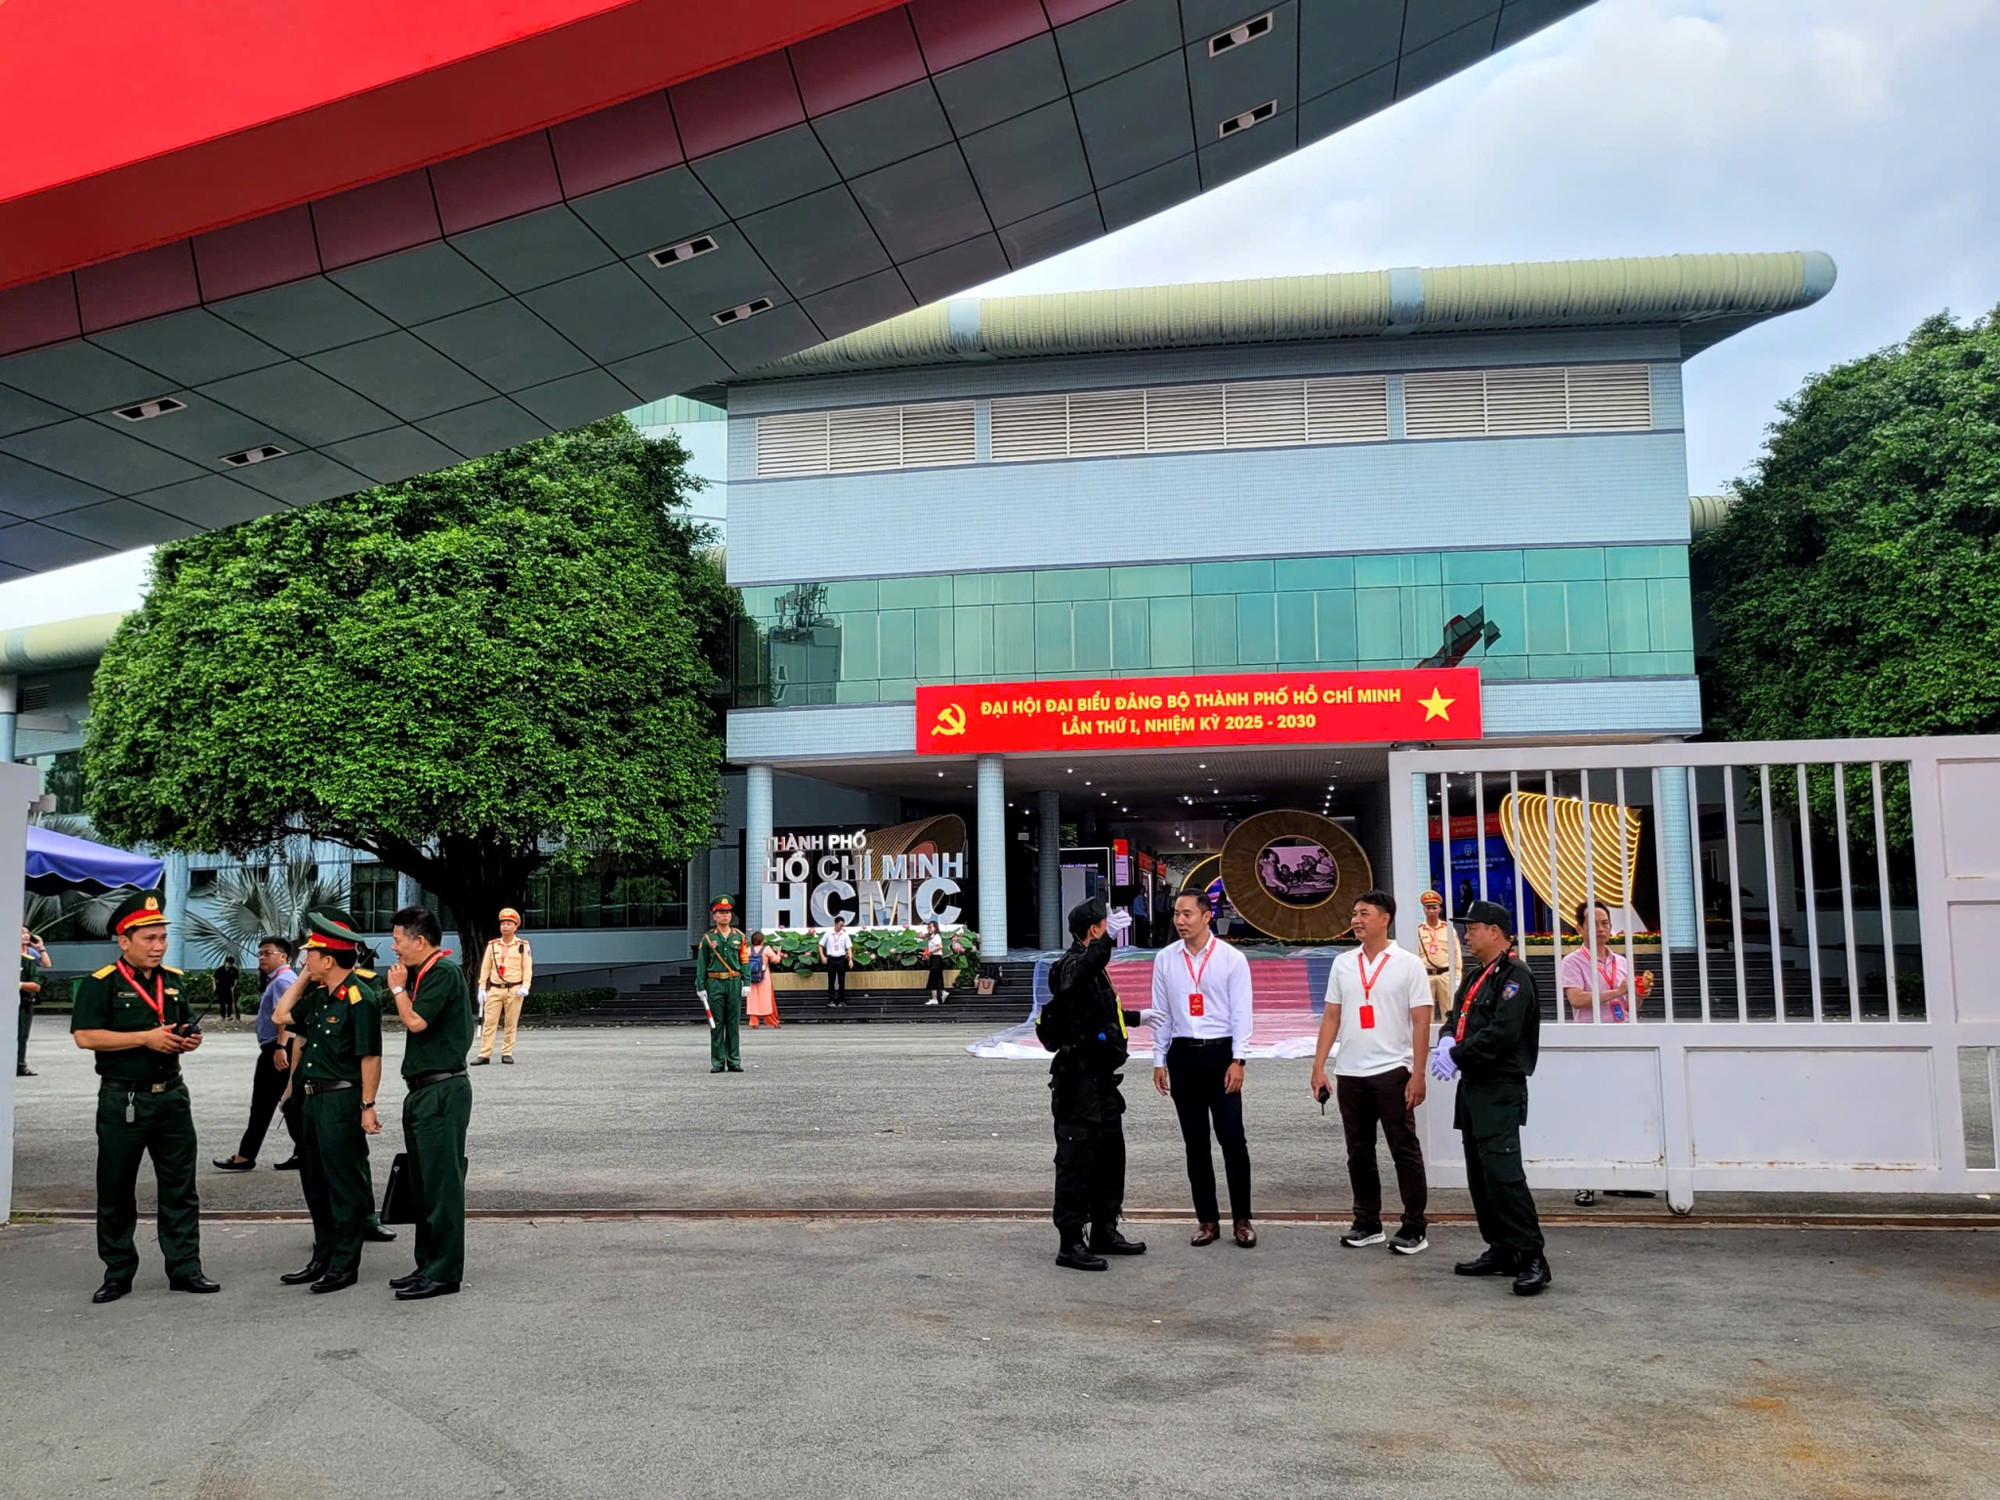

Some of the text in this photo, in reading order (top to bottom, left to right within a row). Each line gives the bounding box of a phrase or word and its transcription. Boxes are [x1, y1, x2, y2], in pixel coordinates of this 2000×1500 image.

[981, 684, 1401, 718] ĐẠI HỘI ĐẠI BIỂU ĐẢNG BỘ THÀNH PHỐ HỒ CHÍ MINH
[1062, 715, 1092, 735] LẦN
[1096, 716, 1127, 734] THỨ
[1130, 720, 1140, 735] I,
[1144, 714, 1195, 735] NHIỆM
[1199, 713, 1221, 731] KỲ
[1225, 715, 1263, 730] 2025
[1277, 714, 1316, 729] 2030
[764, 829, 867, 851] THÀNH PHỐ
[766, 849, 965, 882] HỒ CHÍ MINH
[761, 877, 962, 928] HCMC
